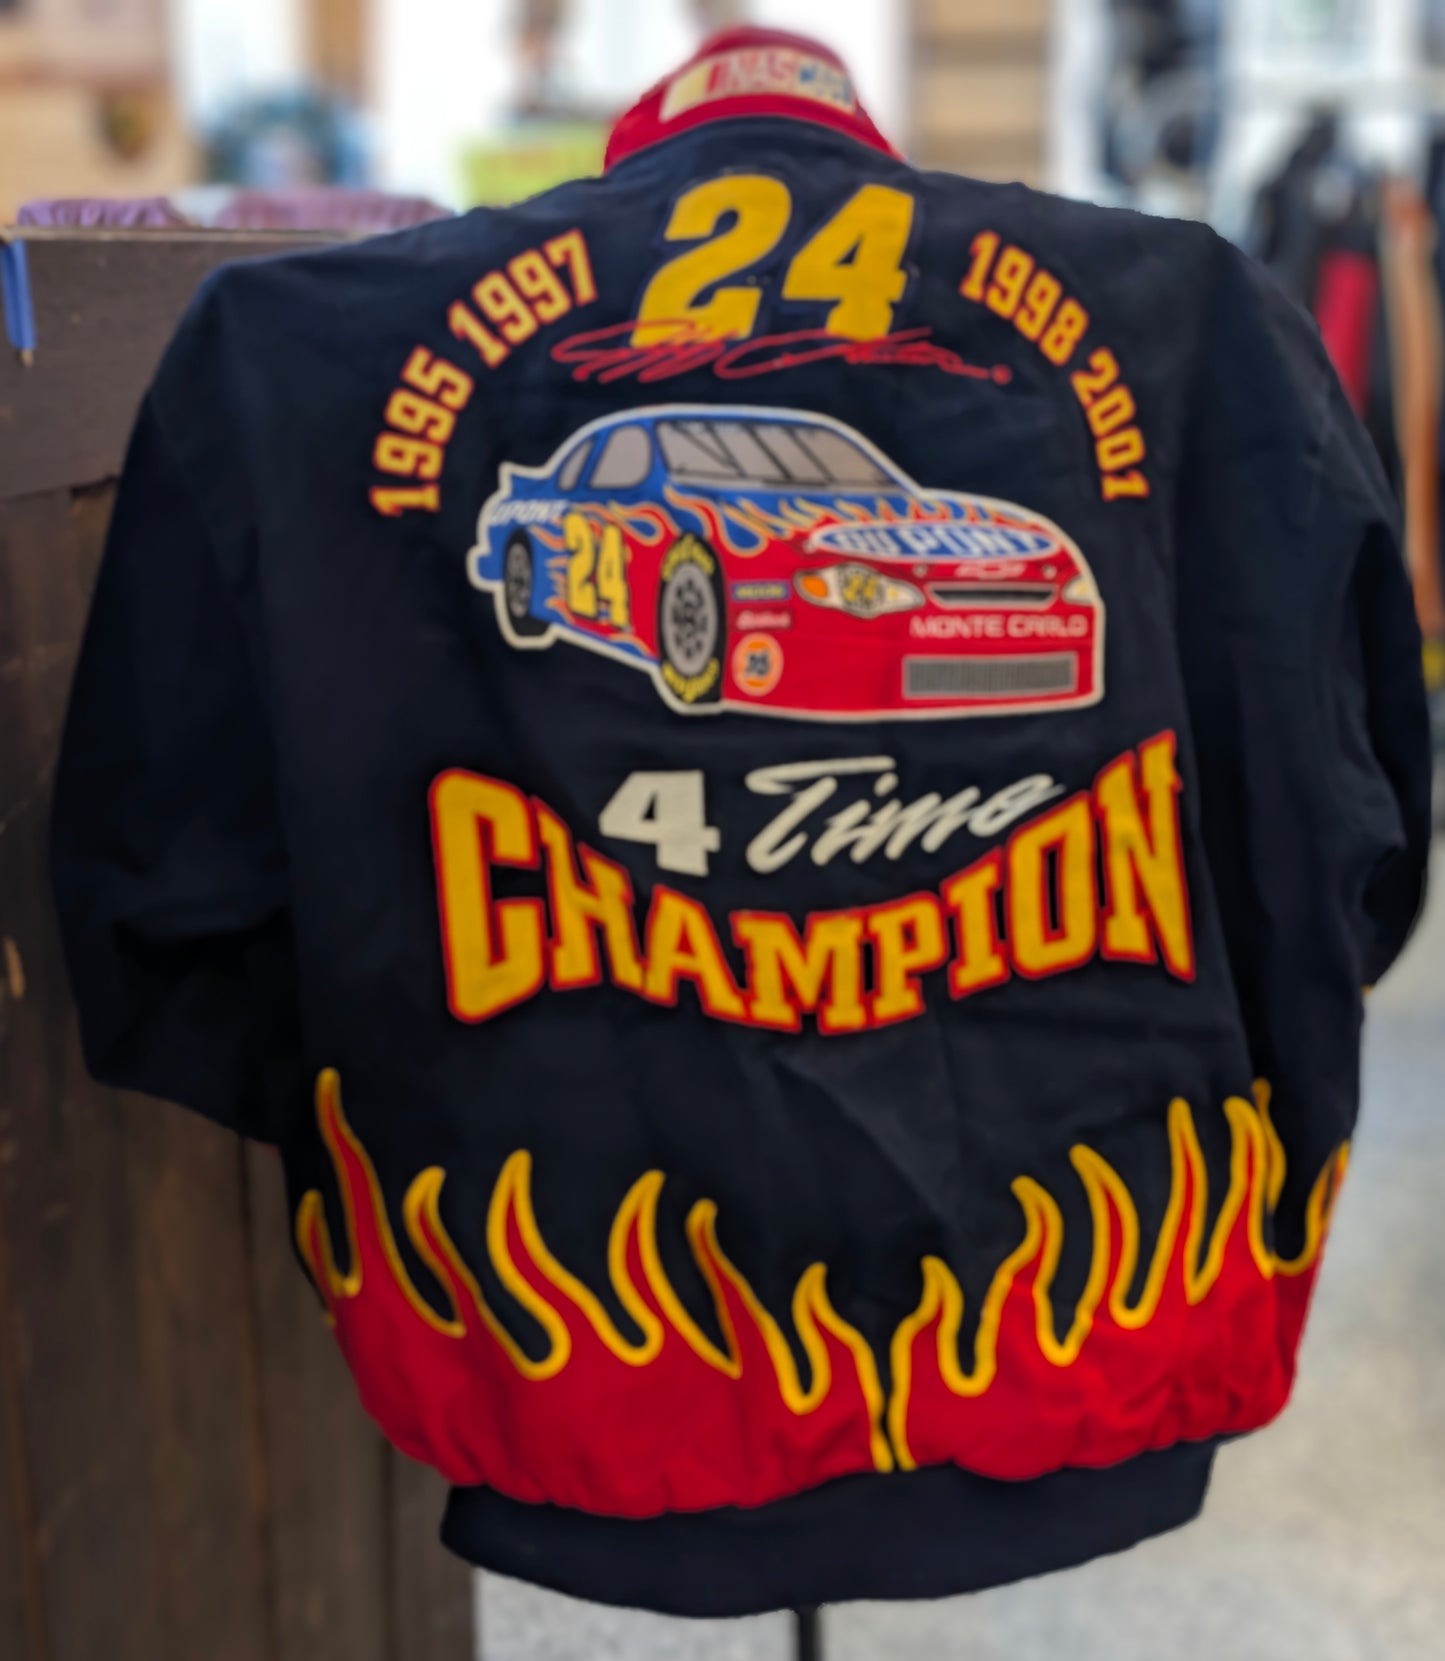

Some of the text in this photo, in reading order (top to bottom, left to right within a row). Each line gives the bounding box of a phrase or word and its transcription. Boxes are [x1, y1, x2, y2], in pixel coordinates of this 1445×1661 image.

[629, 174, 914, 348] 24
[368, 228, 597, 516] 1995 1997
[959, 229, 1150, 502] 1998 2001
[563, 512, 629, 628] 24
[909, 613, 1089, 639] MONTE CARLO
[428, 729, 1196, 1036] CHAMPION
[600, 770, 720, 876] 4
